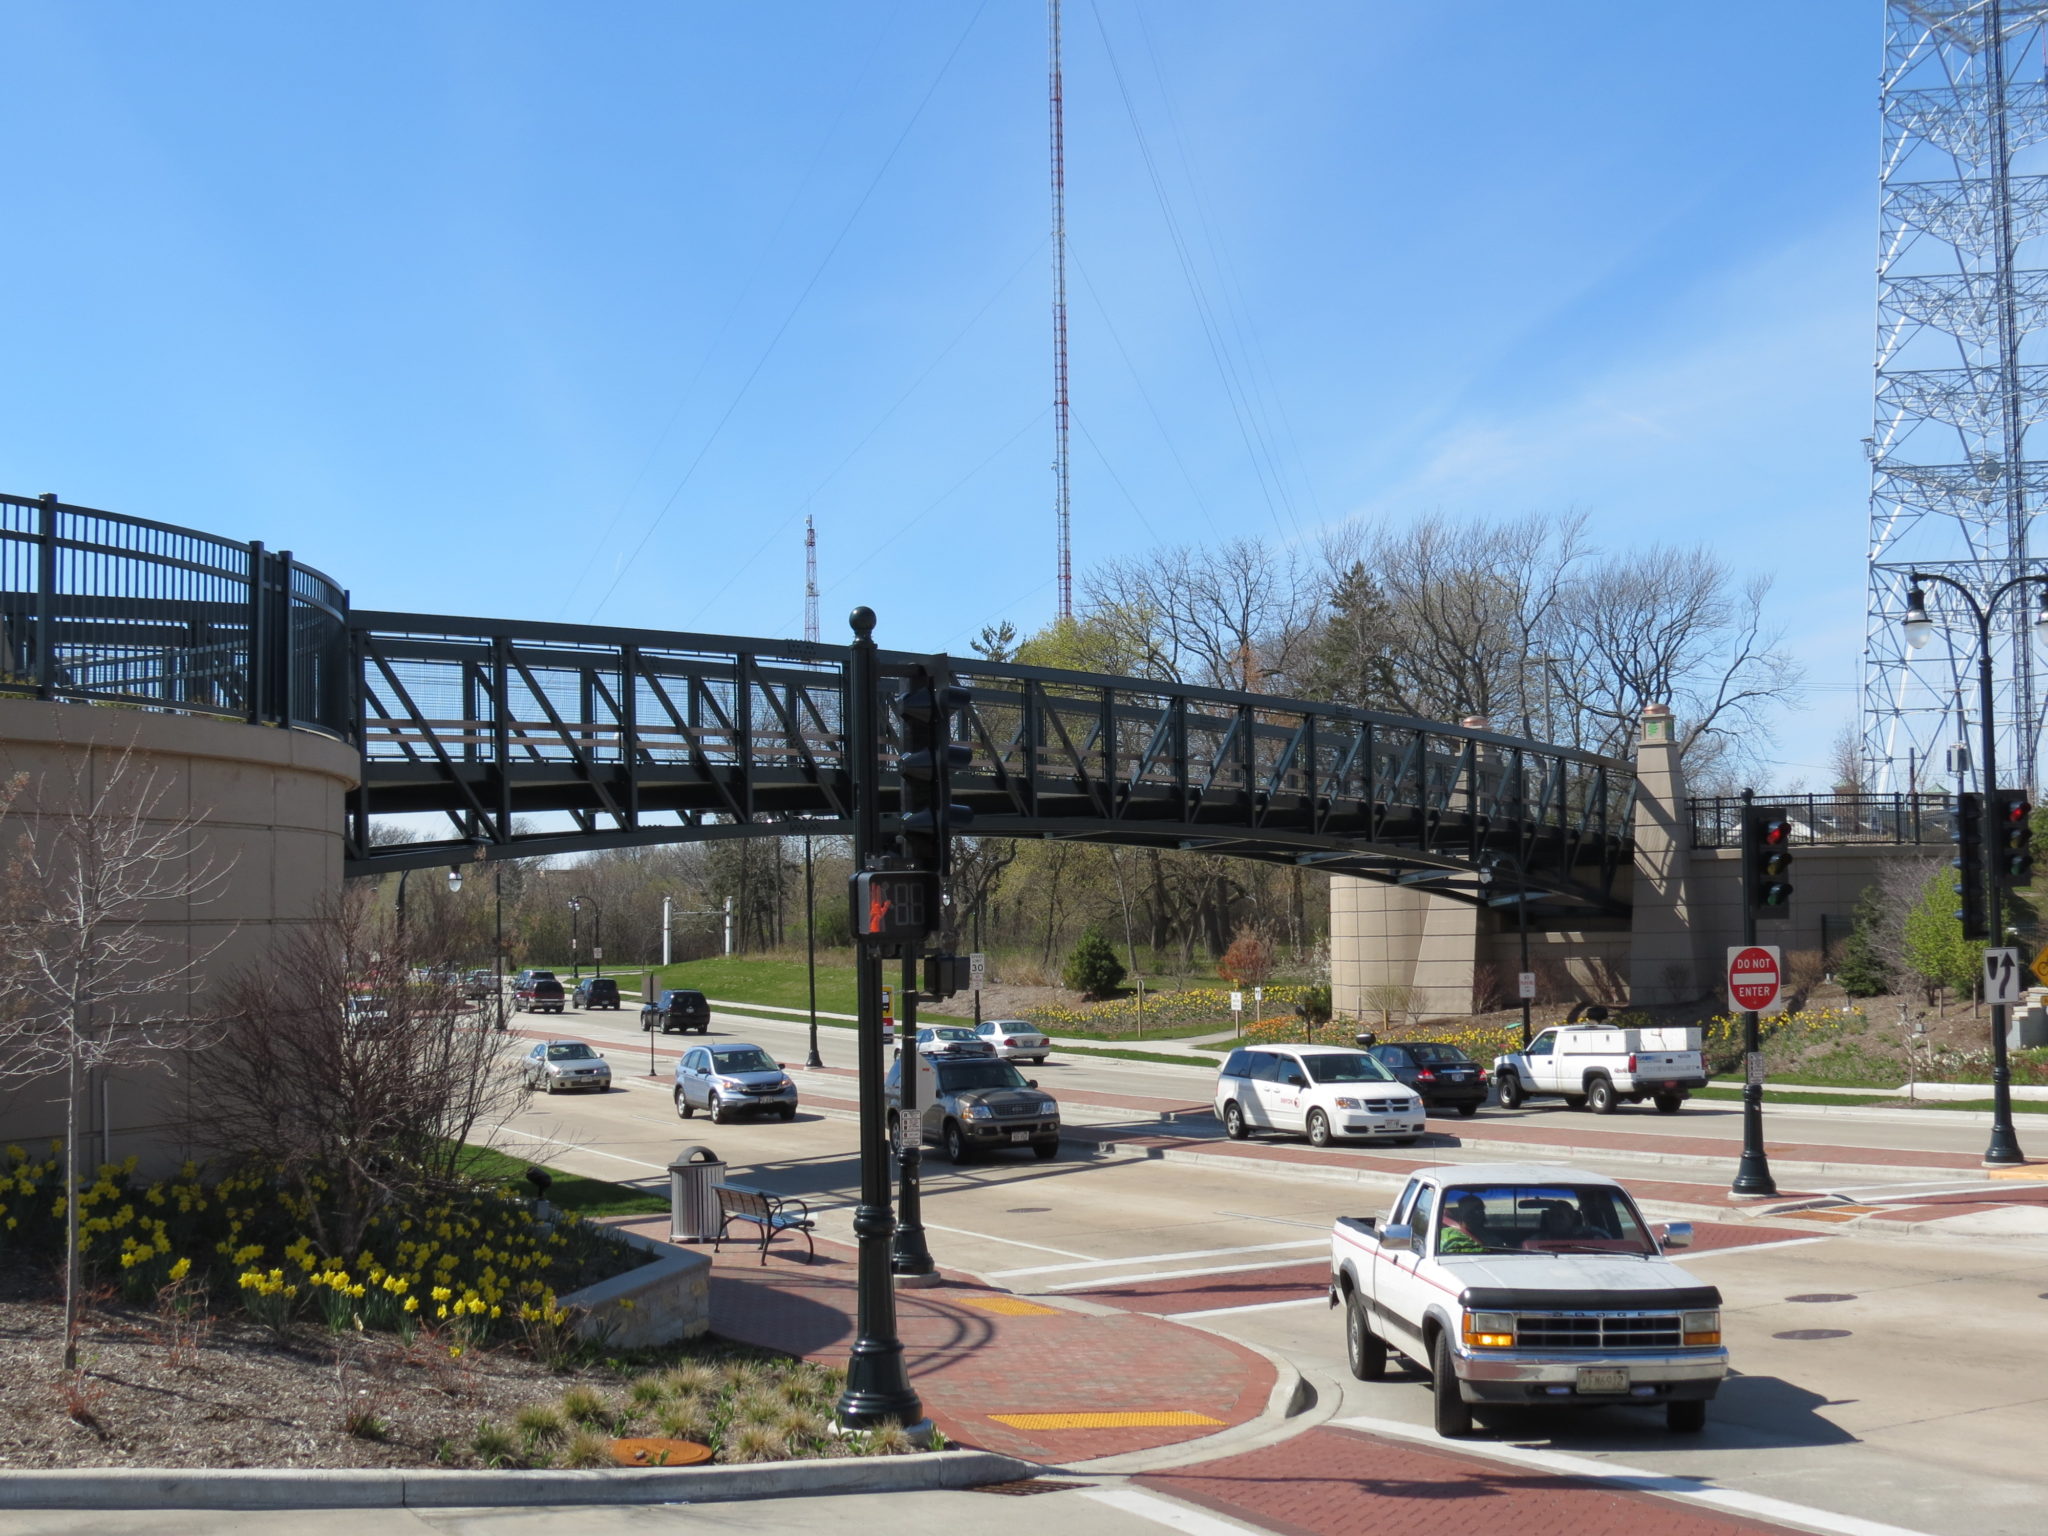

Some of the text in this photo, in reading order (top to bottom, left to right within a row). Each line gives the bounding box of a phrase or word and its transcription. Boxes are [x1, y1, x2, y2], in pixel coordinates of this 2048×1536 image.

[972, 964, 984, 972] 30
[1737, 958, 1771, 969] DO NOT
[1739, 986, 1771, 997] ENTER
